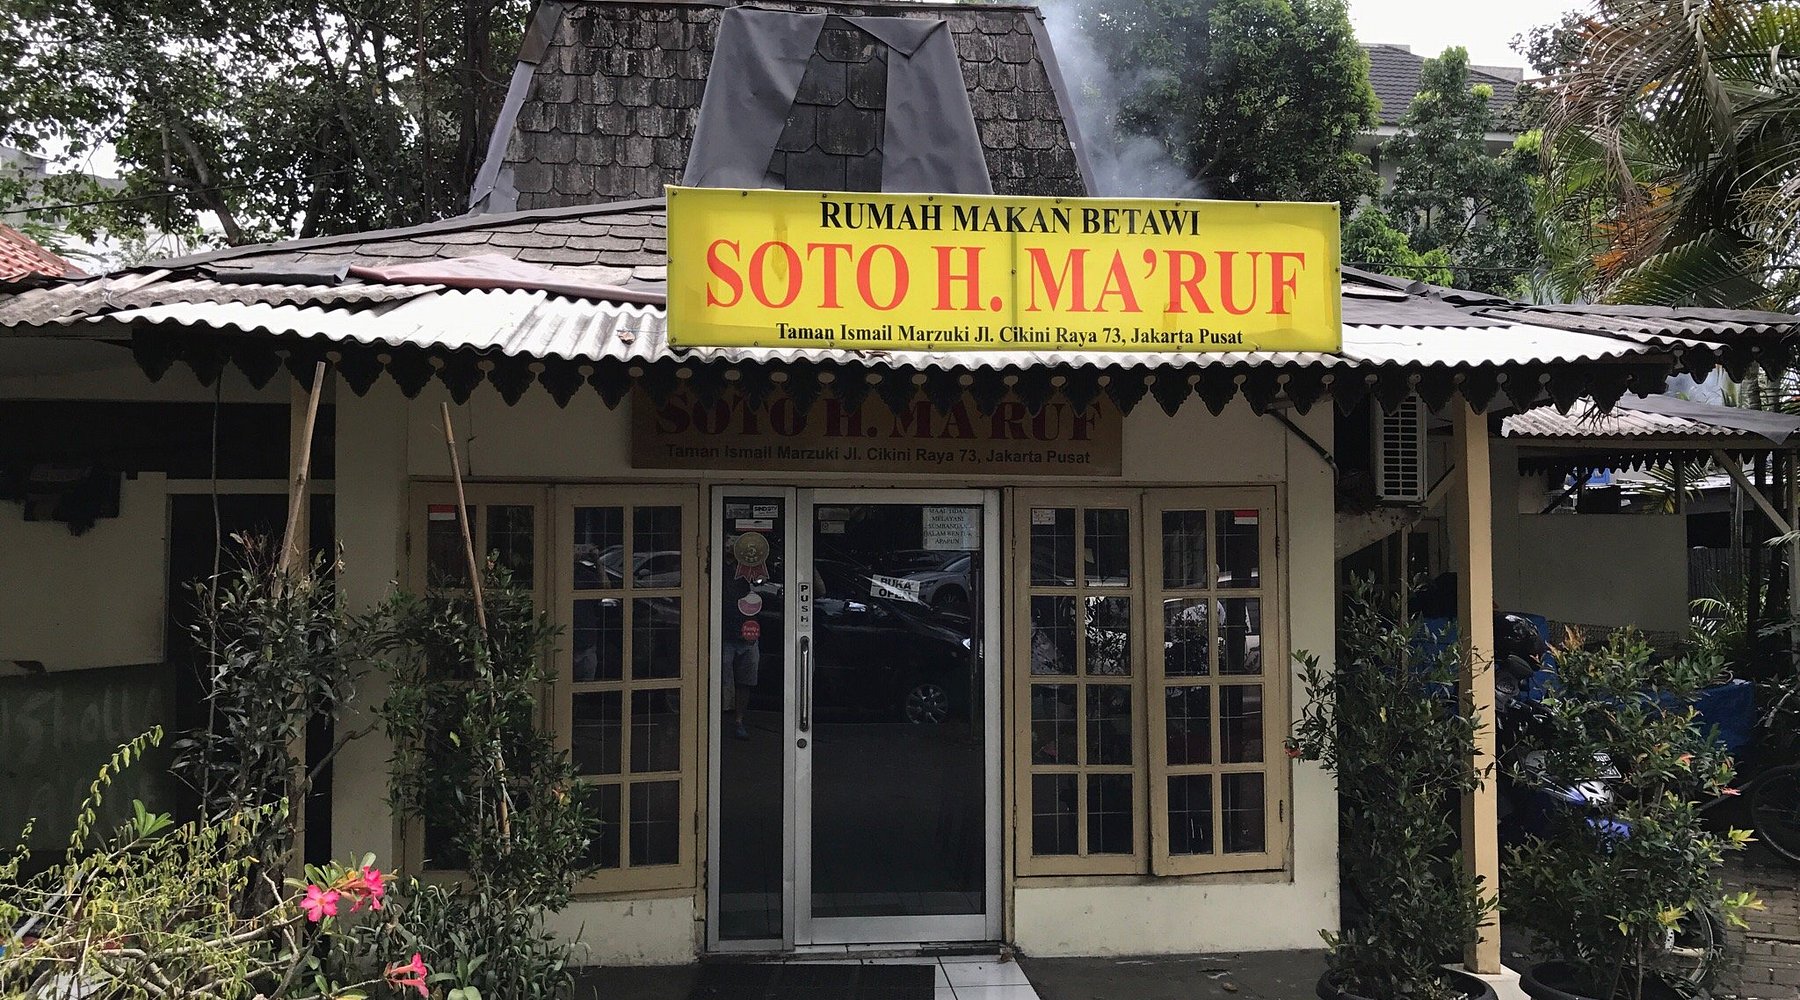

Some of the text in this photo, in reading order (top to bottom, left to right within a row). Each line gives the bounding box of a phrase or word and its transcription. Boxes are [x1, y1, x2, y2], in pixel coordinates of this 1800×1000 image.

[820, 201, 1200, 236] RUMAH MAKAN BETAWI
[706, 238, 1305, 316] SOTO H. MA'RUF
[776, 322, 1243, 348] Taman Ismail Marzuki Jl. Cikini Raya 73, Jakarta Pusat
[656, 393, 807, 437] SOTO
[823, 398, 877, 438] H.
[666, 443, 1090, 465] Taman Ismail Marzuki Jl. Cikini Raya 73, Jakarta Pusat
[800, 584, 809, 622] PUSH
